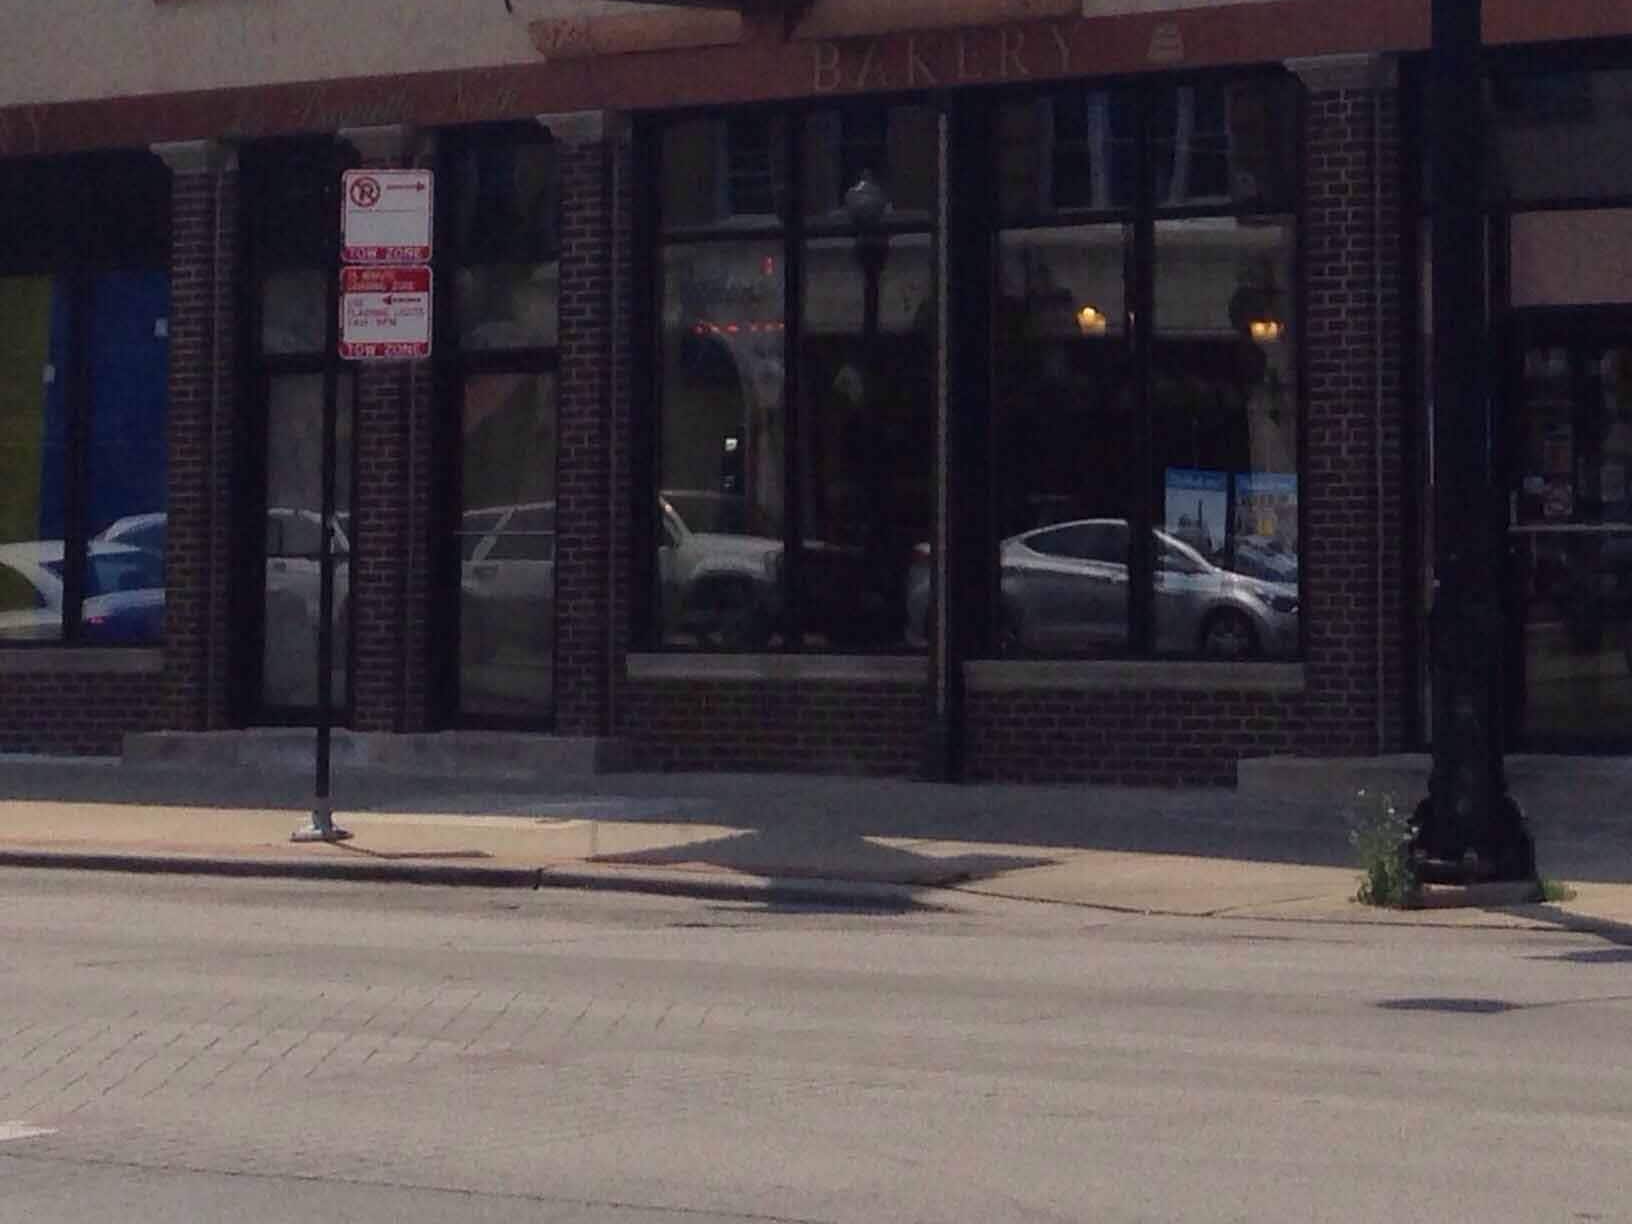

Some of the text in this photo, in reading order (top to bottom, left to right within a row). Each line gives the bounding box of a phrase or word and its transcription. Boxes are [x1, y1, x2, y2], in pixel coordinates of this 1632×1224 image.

[812, 22, 1081, 93] BAKERY
[349, 246, 424, 259] TOW ZONE
[347, 343, 421, 356] TOW ZONE
